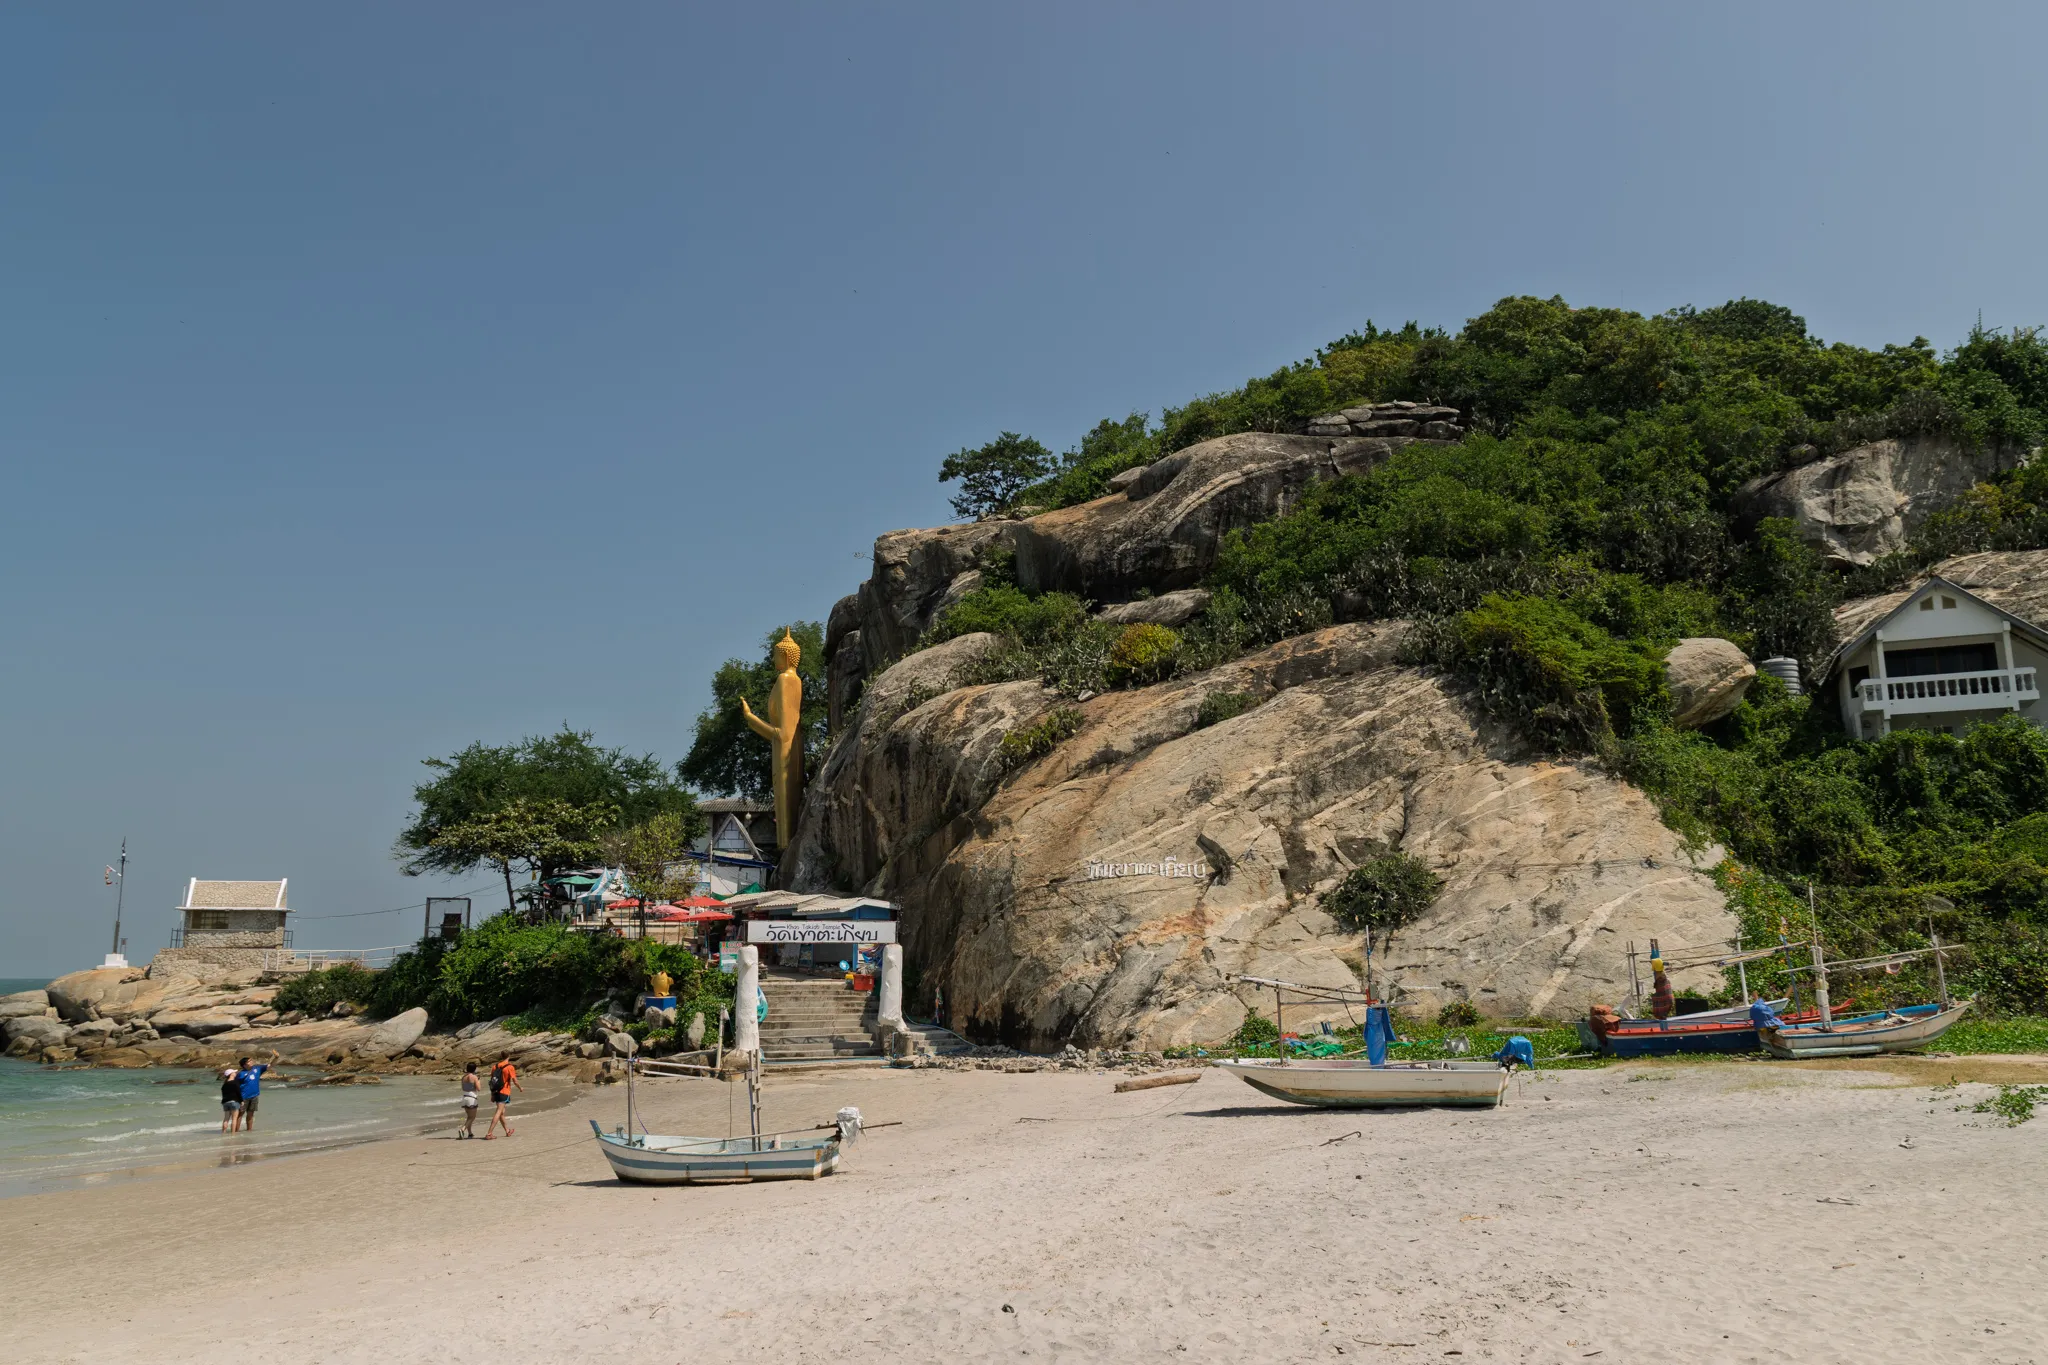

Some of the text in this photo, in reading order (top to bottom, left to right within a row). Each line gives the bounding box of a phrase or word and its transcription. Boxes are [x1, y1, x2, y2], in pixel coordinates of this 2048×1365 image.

[766, 922, 878, 942] วัดเขาตะเกียบ
[822, 923, 841, 931] Temple
